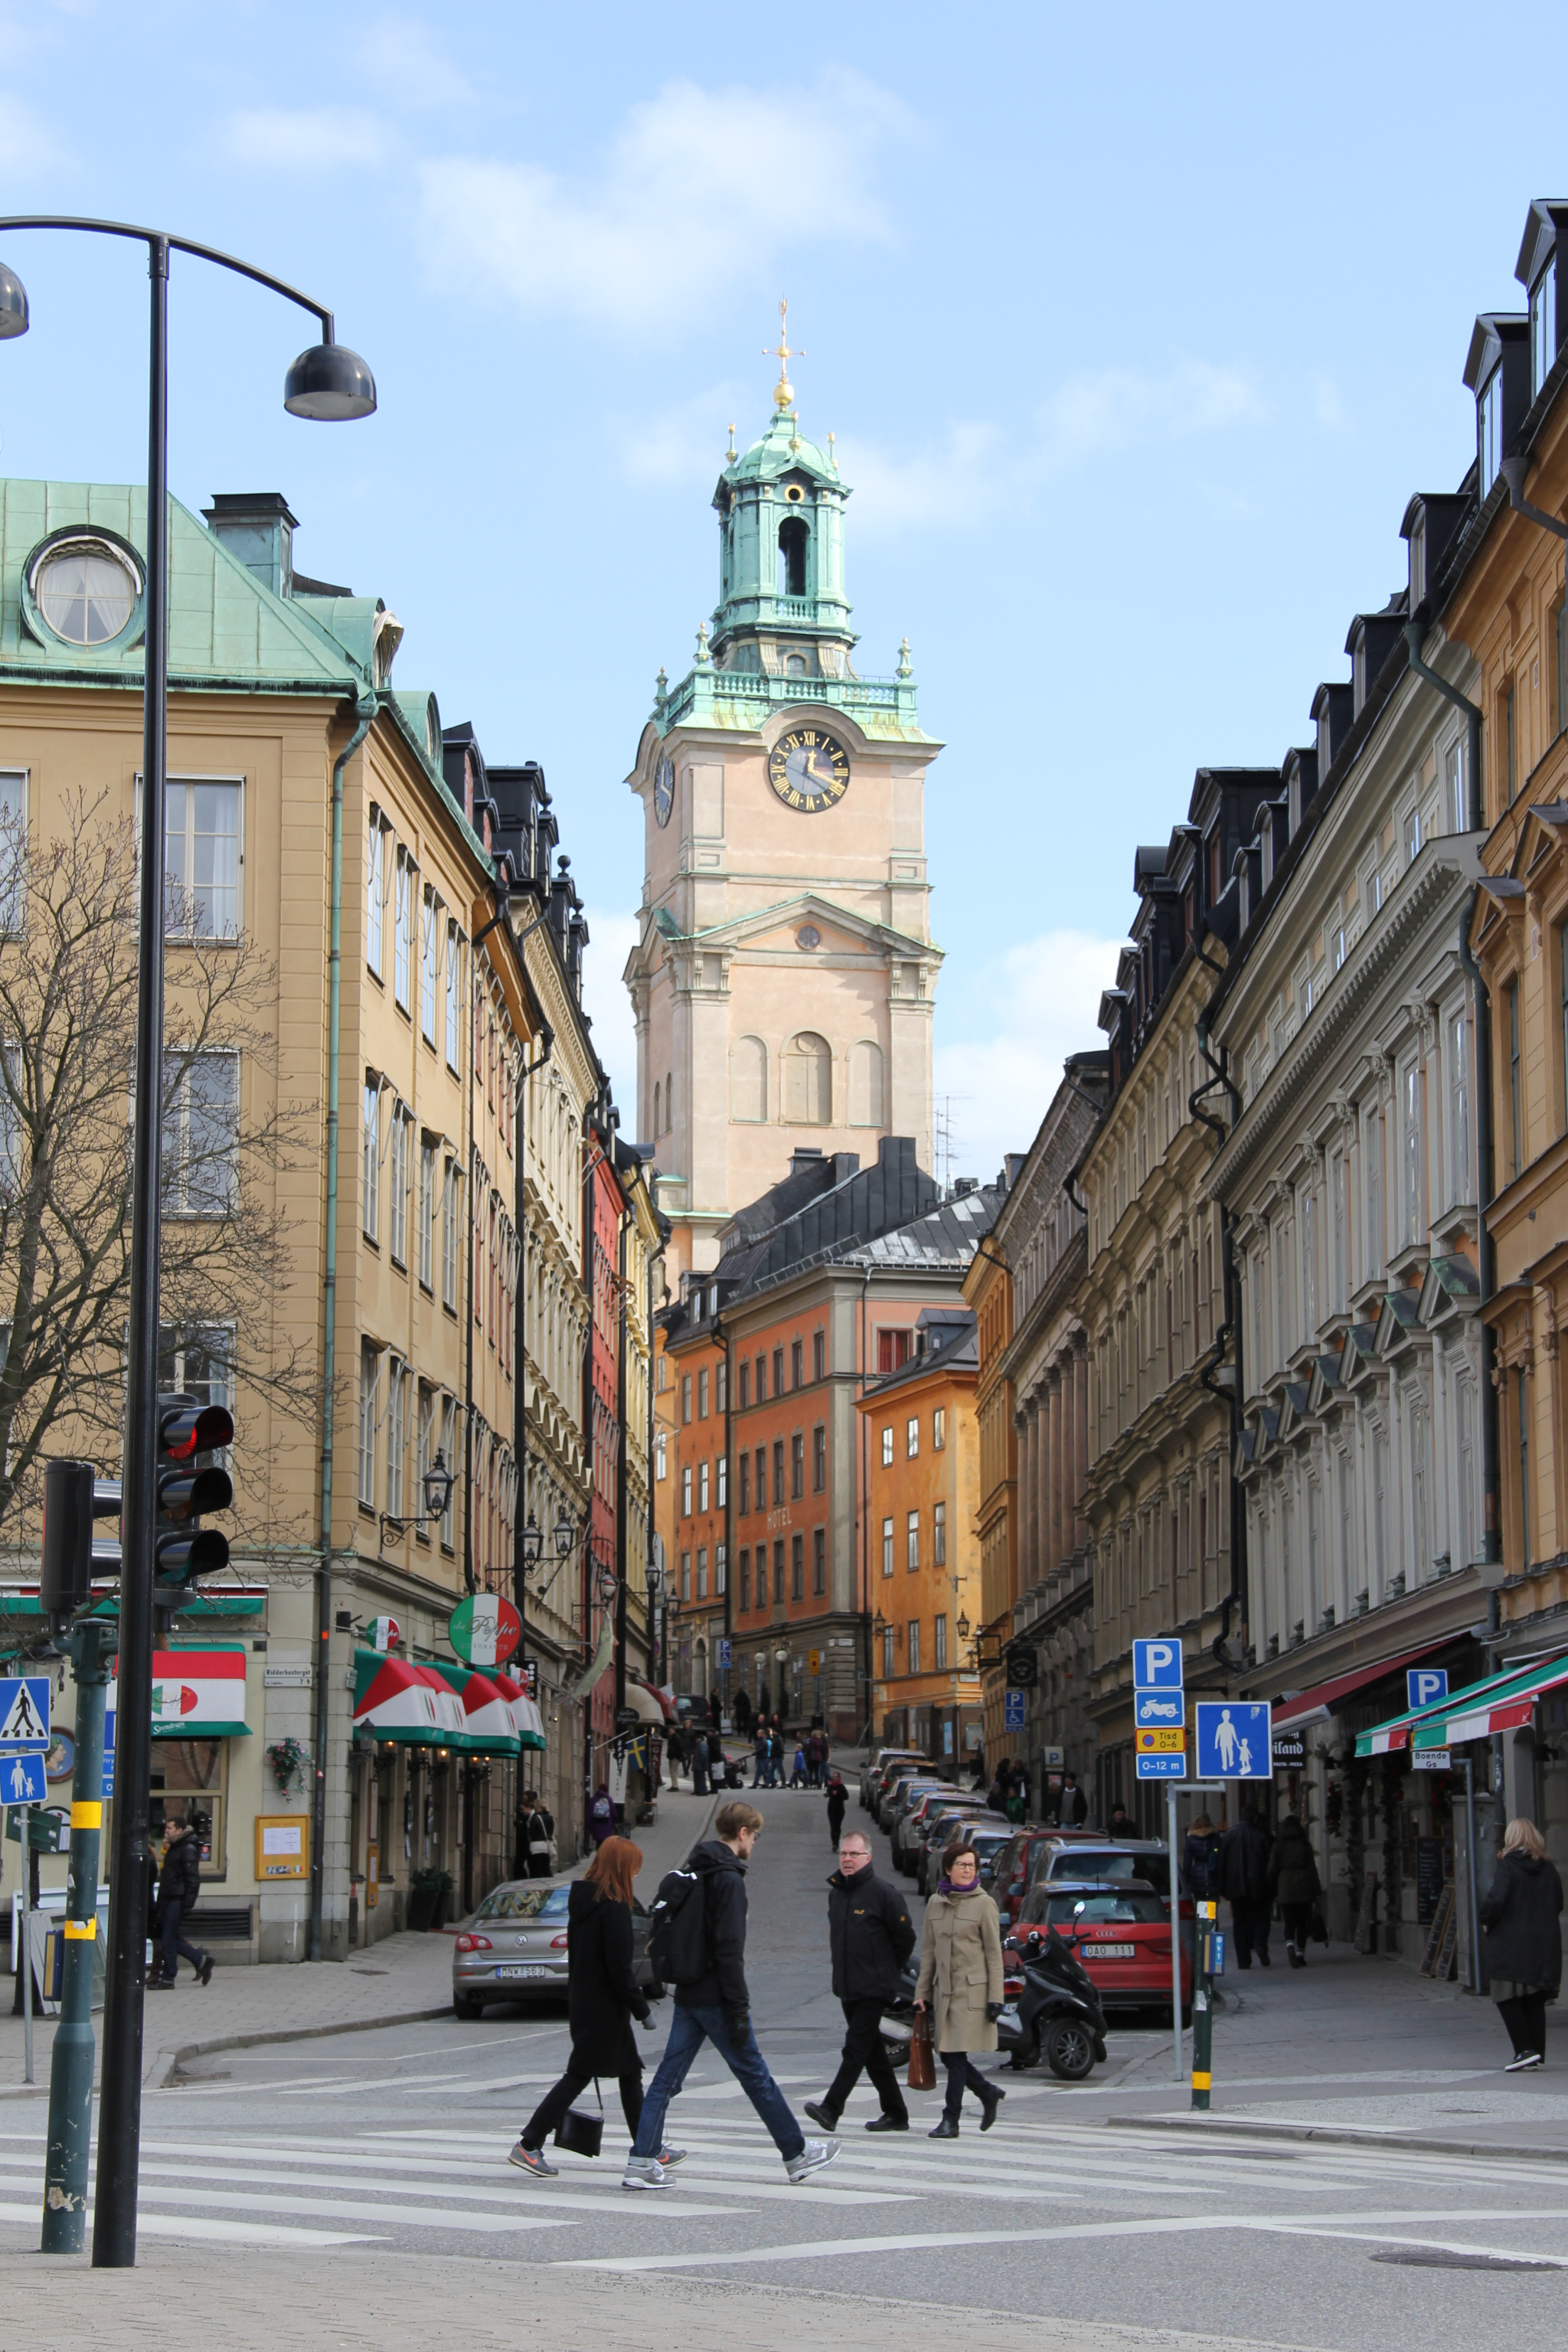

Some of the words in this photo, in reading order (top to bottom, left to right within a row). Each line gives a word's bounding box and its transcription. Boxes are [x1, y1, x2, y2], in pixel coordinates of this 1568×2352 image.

[767, 1506, 792, 1530] HOTEL
[466, 1615, 517, 1642] Peppe
[723, 1641, 730, 1651] P
[1146, 1645, 1173, 1683] P
[1418, 1674, 1440, 1704] P
[1011, 1694, 1021, 1706] P
[153, 1722, 185, 1735] Spendrups
[1050, 1753, 1059, 1763] P
[1142, 1761, 1167, 1770] 0-12
[1115, 1946, 1132, 1955] 111
[526, 1966, 543, 1975] 563
